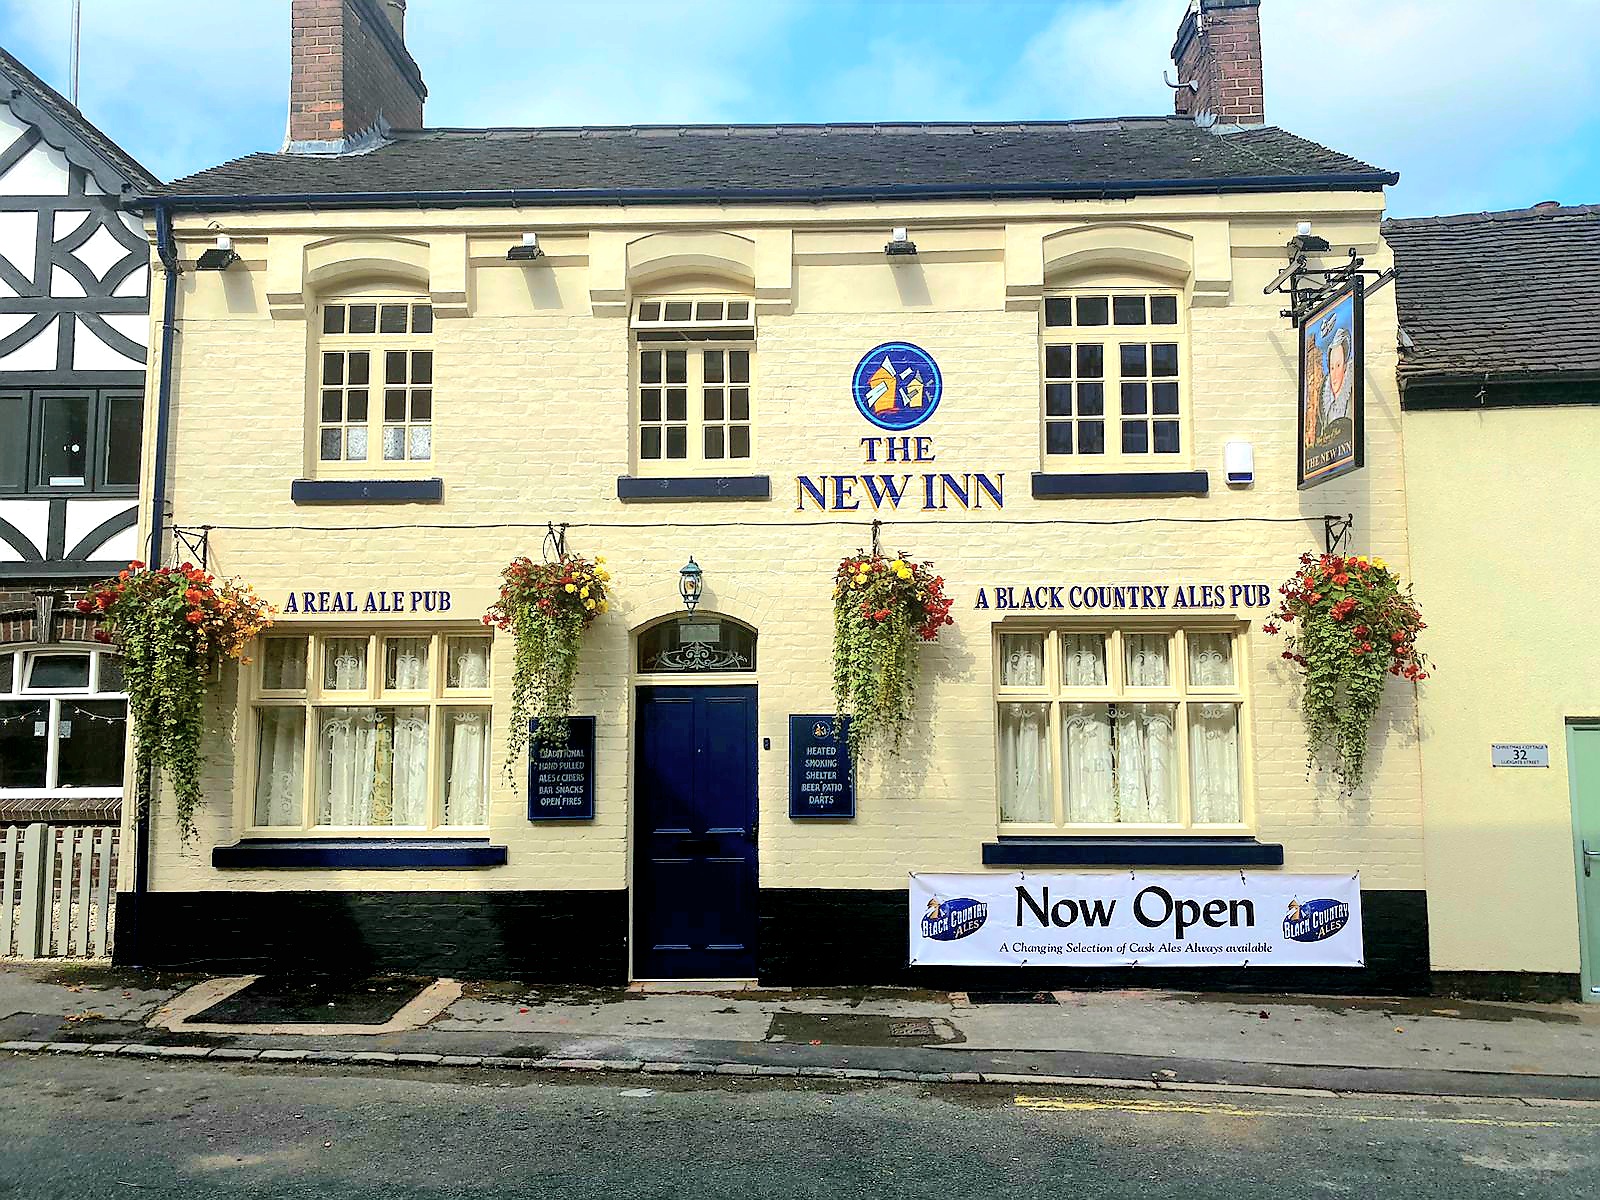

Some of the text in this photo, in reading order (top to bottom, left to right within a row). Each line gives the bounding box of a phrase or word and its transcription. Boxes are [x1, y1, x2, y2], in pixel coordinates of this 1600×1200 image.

[861, 437, 936, 464] THE
[1306, 441, 1352, 469] THE NEW INN
[795, 473, 1005, 512] NEW INN
[284, 591, 451, 613] A REAL ALE PUB
[974, 585, 1271, 609] A BLACK COUNTRY ALES PUB
[807, 746, 836, 756] HEATED
[1513, 749, 1527, 760] 32
[539, 761, 584, 771] HAND PULLED
[804, 759, 837, 768] SMOKING
[539, 774, 555, 783] ALES
[561, 773, 584, 783] CIDERS
[806, 771, 836, 780] SHELTER
[539, 785, 584, 795] BAR SNACKS
[801, 783, 843, 792] BEER PATIO
[540, 796, 582, 806] OPEN FIRES
[809, 796, 834, 805] DARTS
[1015, 886, 1255, 940] Now Open
[922, 903, 987, 937] BLACK COUNTRY
[1284, 903, 1348, 939] BLACK COUNTRY
[954, 919, 980, 939] ALES
[1317, 919, 1342, 940] ALES
[999, 942, 1273, 955] A Changing Selection of Cask Ales Always available
